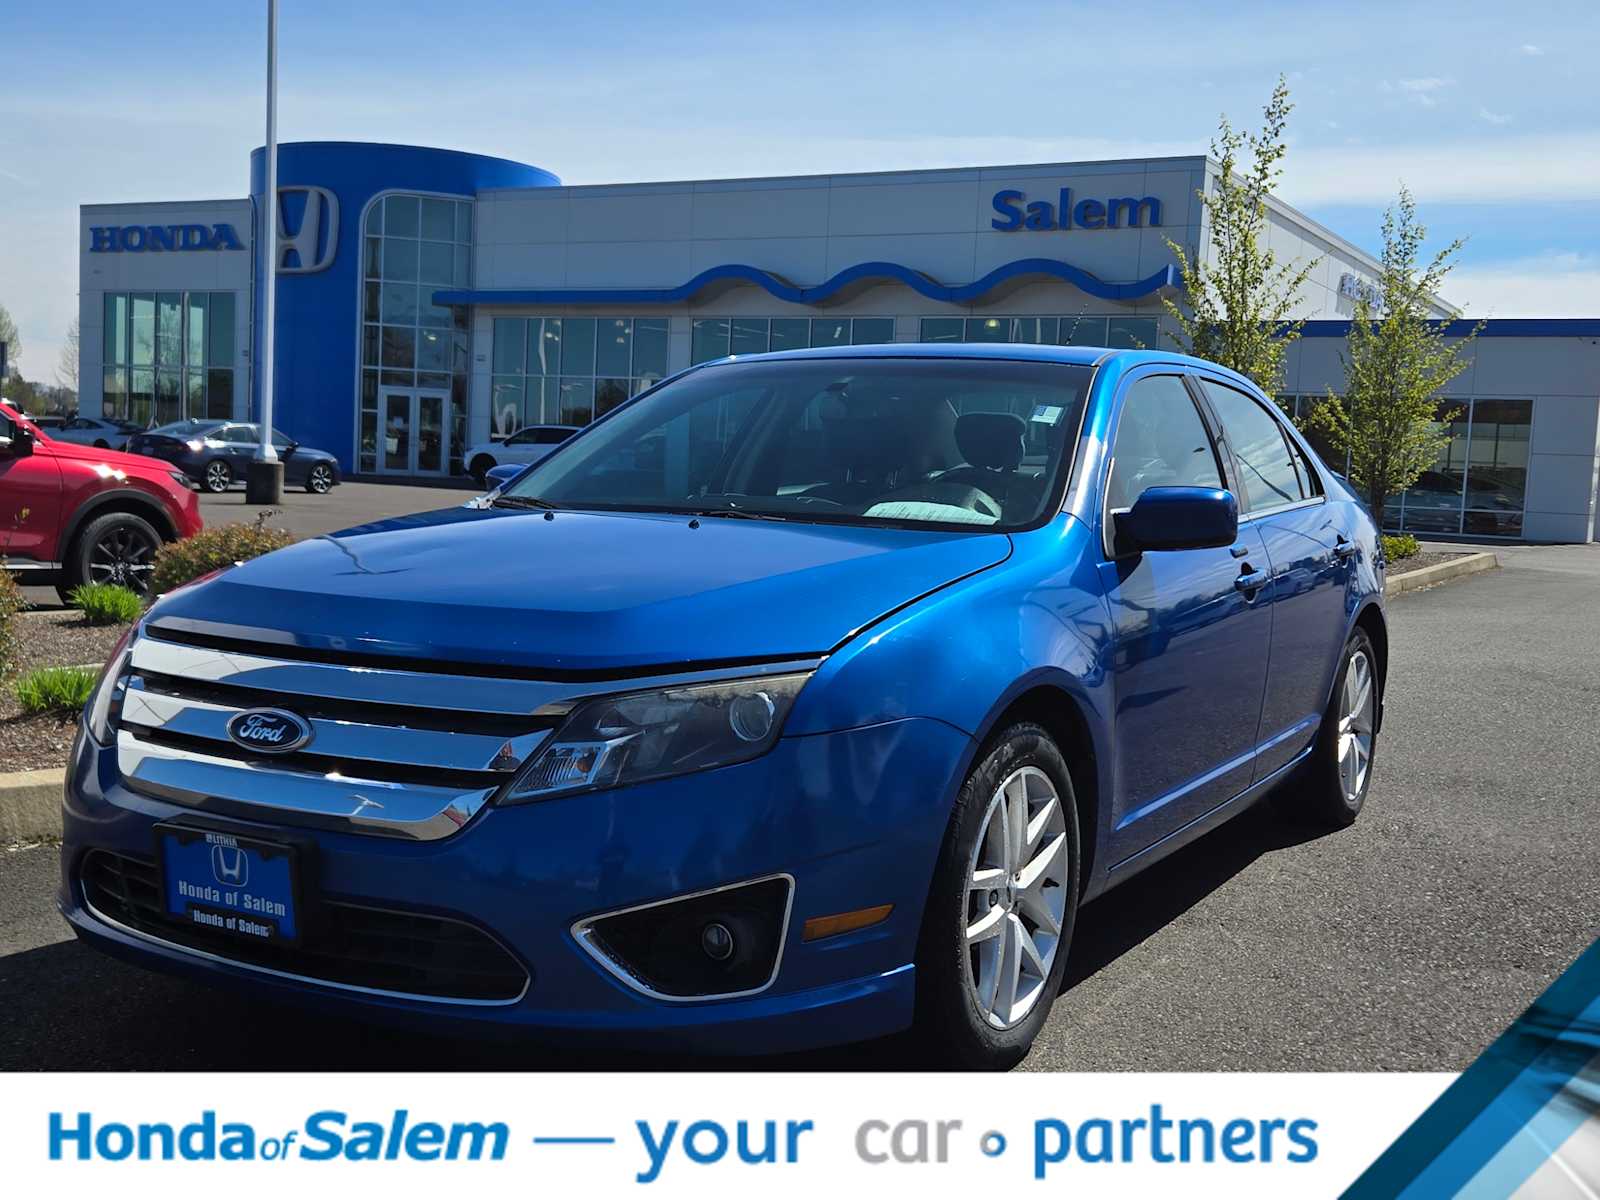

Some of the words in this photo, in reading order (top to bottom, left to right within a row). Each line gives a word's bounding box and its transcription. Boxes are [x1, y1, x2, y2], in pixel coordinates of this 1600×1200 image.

[991, 187, 1162, 231] Salem
[90, 223, 246, 252] HONDA
[239, 713, 287, 742] Ford
[178, 879, 220, 903] Honda
[225, 891, 239, 907] of
[243, 893, 286, 917] Salem
[193, 909, 224, 927] Honda
[226, 917, 236, 930] of
[238, 919, 270, 937] Salem
